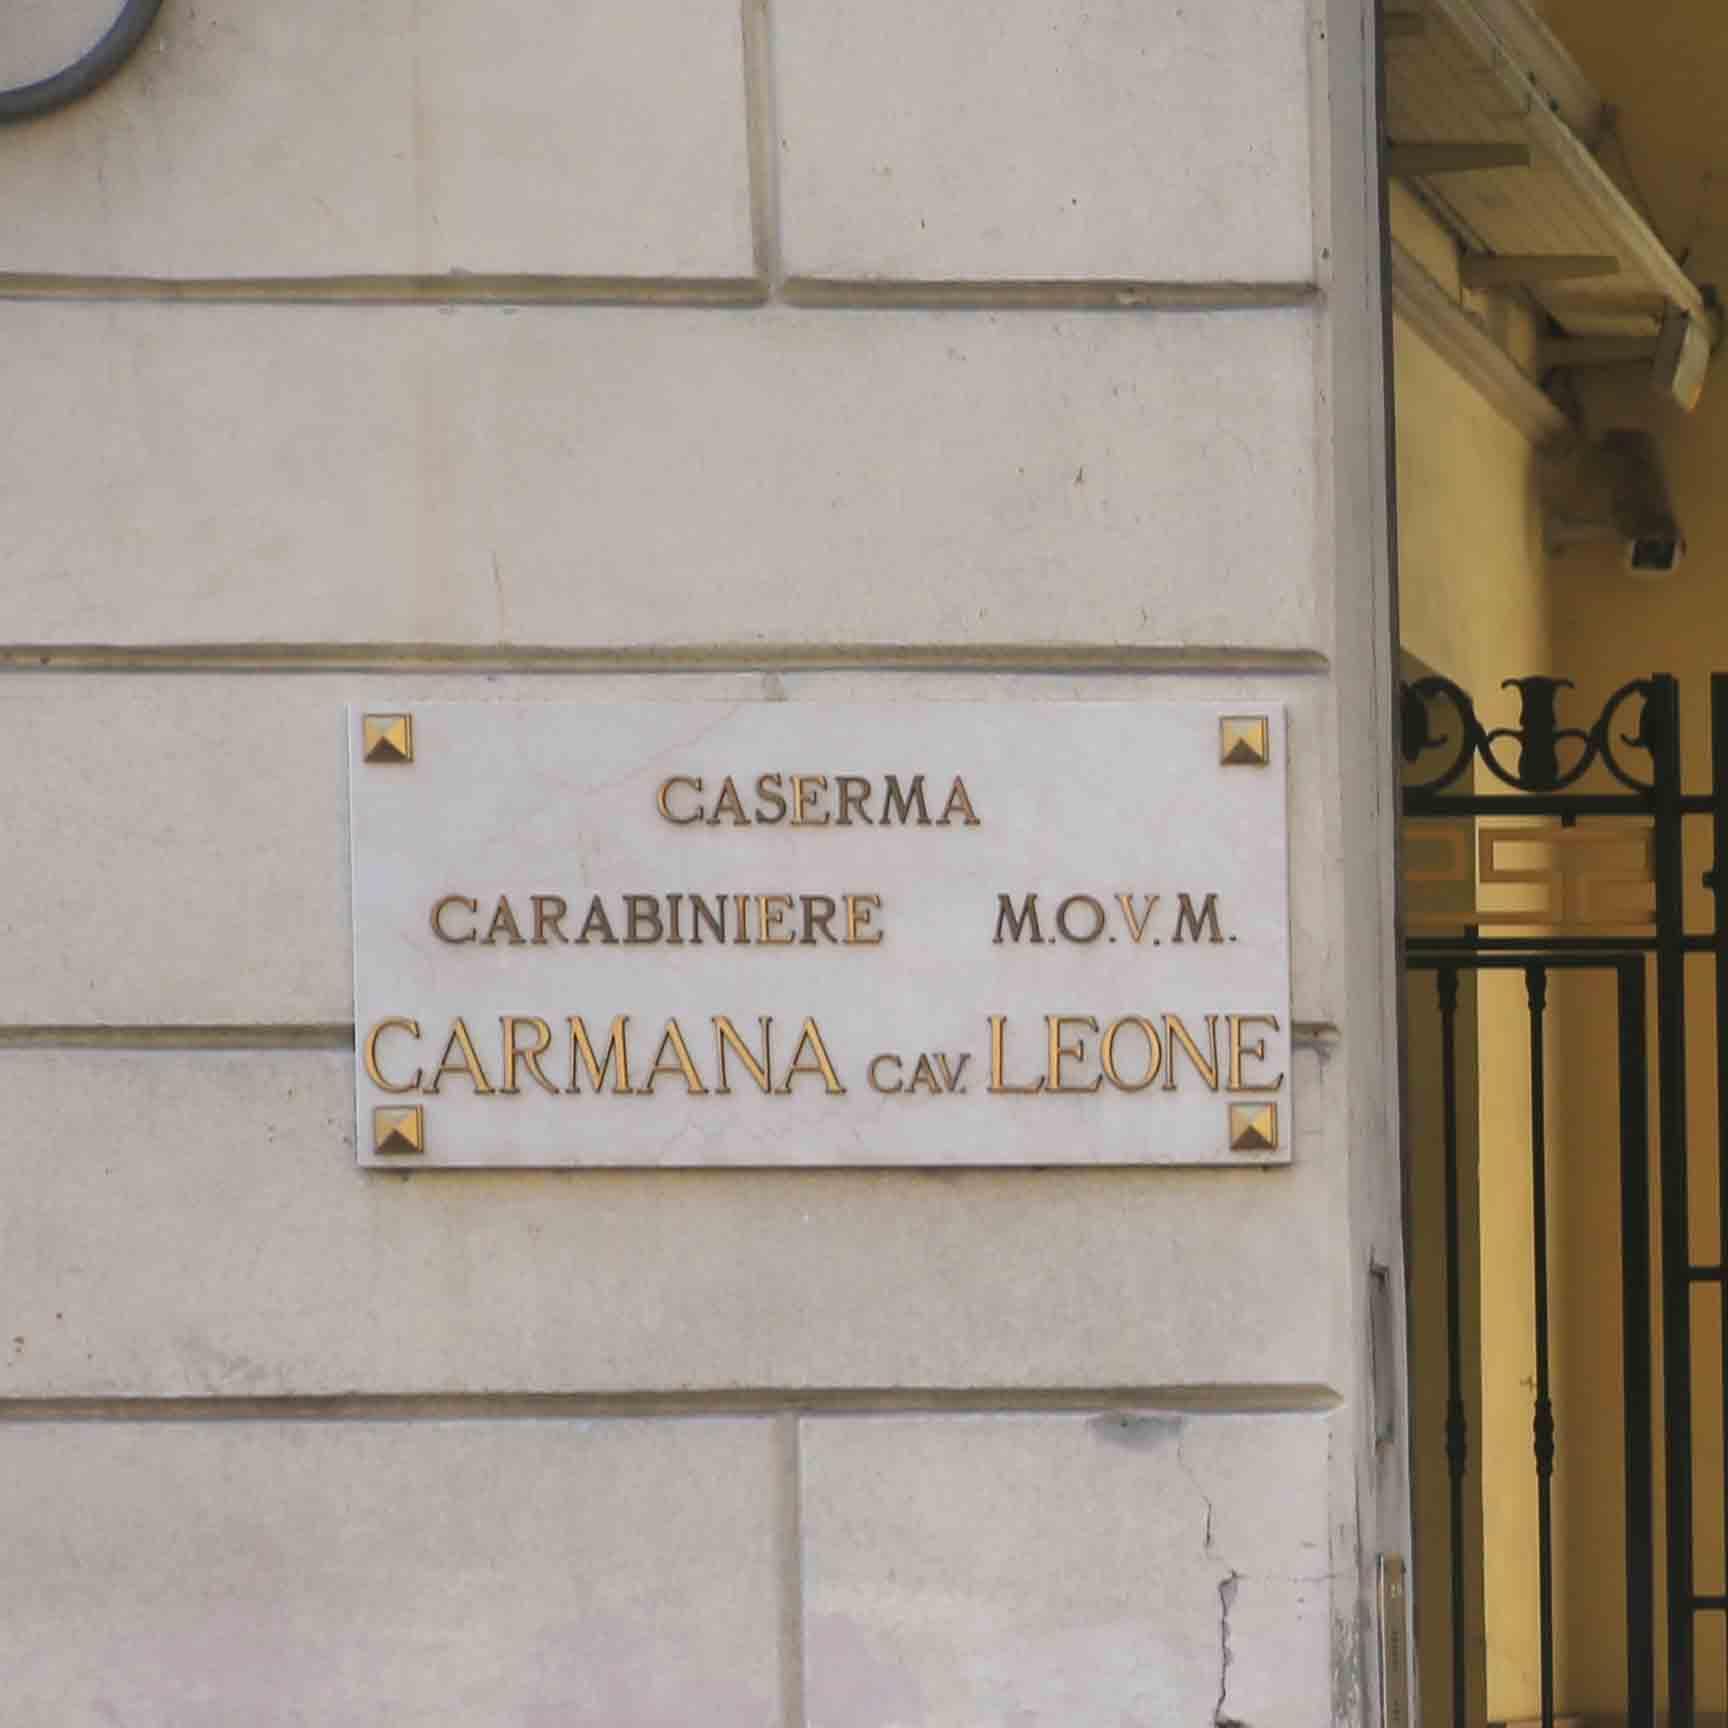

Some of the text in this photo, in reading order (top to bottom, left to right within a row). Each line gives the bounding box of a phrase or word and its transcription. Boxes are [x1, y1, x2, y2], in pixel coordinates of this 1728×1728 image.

[657, 774, 981, 827] CASERMA
[429, 892, 1238, 947] CARABINIERE M.O.V.M.
[362, 1013, 1284, 1097] CARMANA CAV. LEONE
